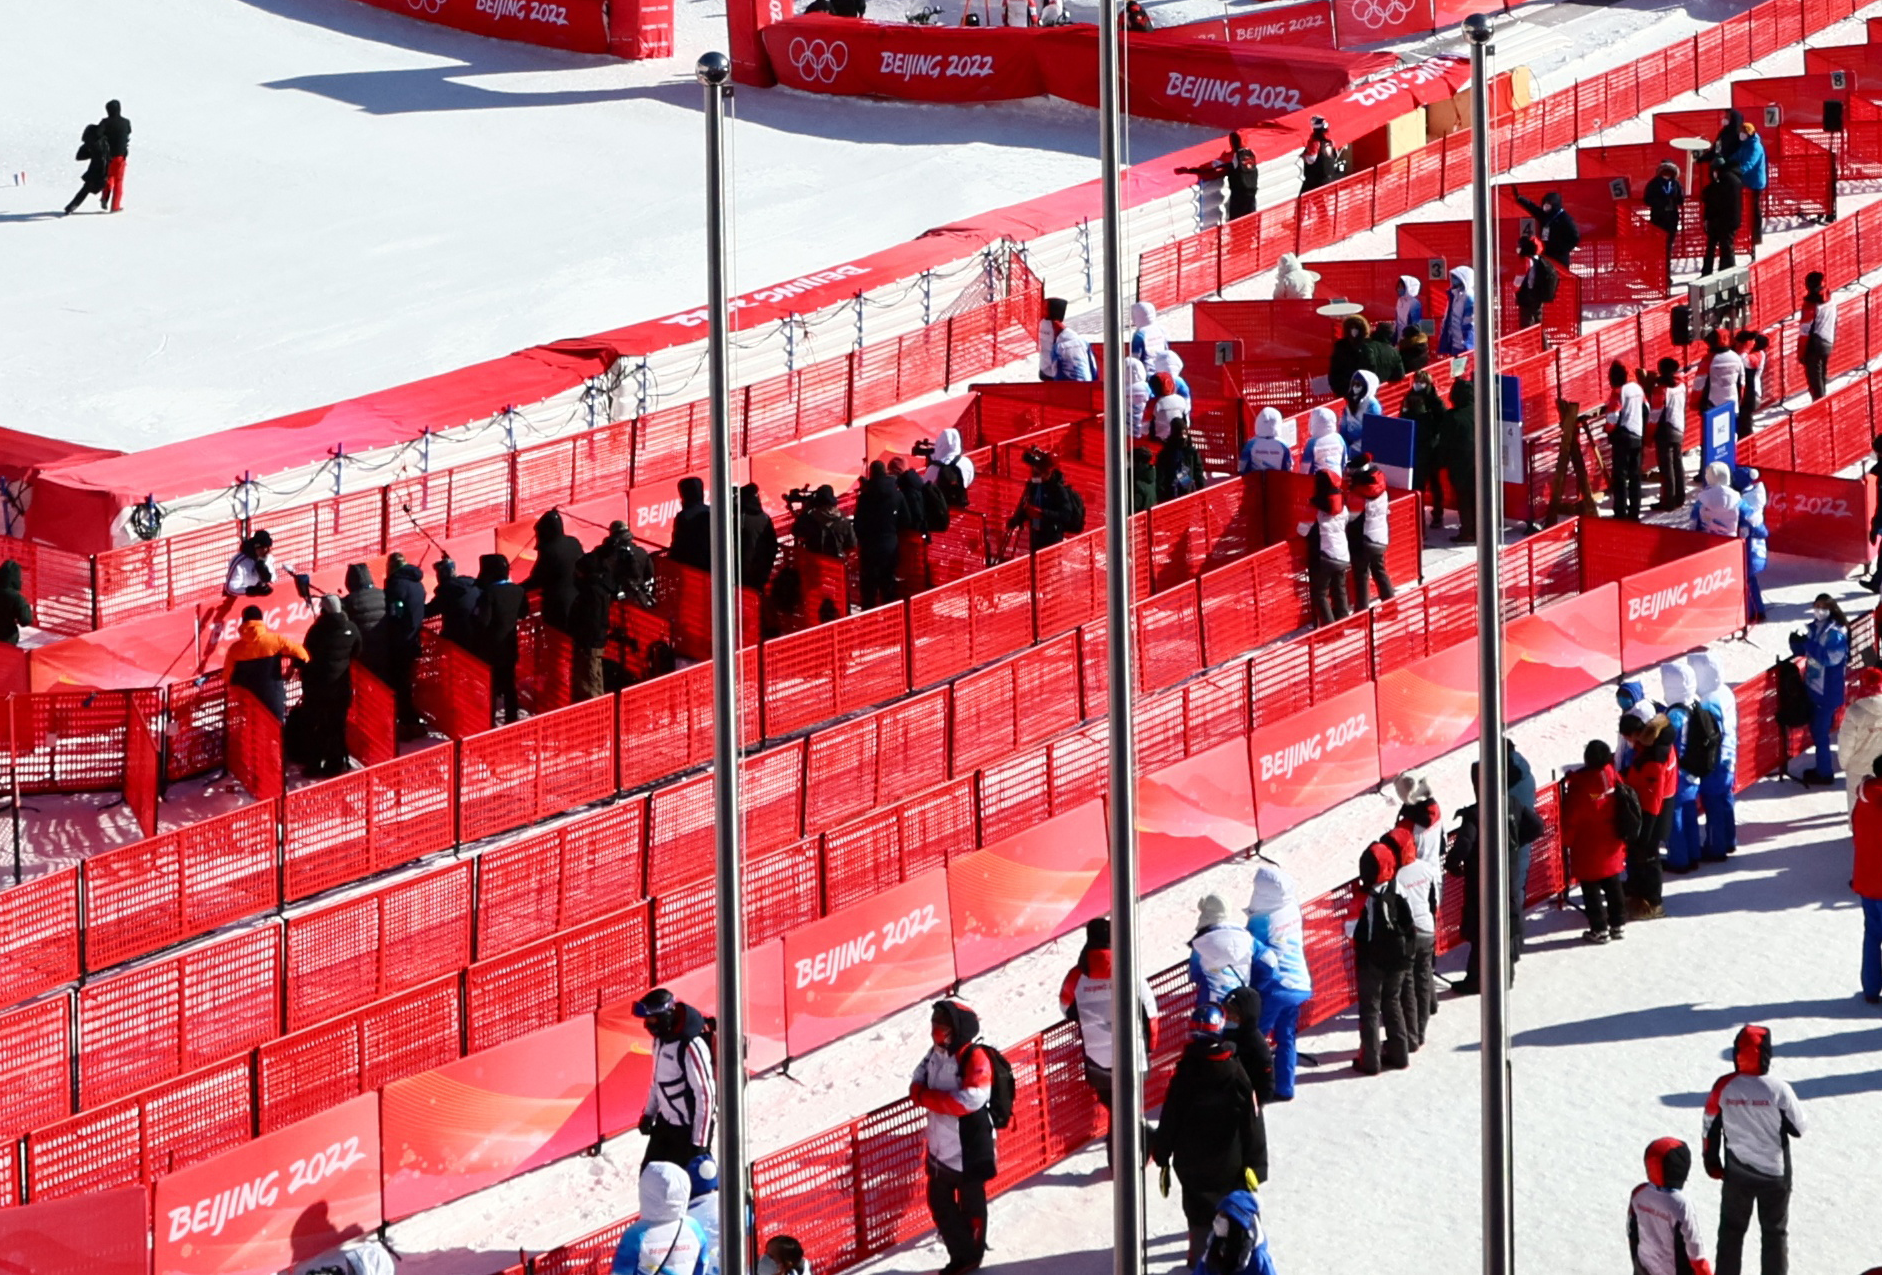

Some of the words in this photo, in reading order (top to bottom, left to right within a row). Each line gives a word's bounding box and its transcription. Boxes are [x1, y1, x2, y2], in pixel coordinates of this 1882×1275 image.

[530, 2, 570, 26] 2022
[1236, 22, 1285, 42] BEIJING
[1288, 15, 1326, 31] 2022
[881, 52, 942, 81] BEIJING
[946, 55, 994, 76] 2022
[1833, 73, 1843, 86] 8
[1166, 72, 1241, 107] BEIJING
[1248, 83, 1306, 112] 2022
[1768, 111, 1776, 122] 7
[1613, 184, 1623, 197] 5
[1522, 223, 1533, 236] 4
[1431, 262, 1442, 277] 3
[754, 264, 873, 304] BEIJING
[1219, 347, 1226, 363] 1
[1794, 489, 1853, 517] 2022
[1627, 582, 1688, 621] BEIJING
[1692, 566, 1736, 594] 2022
[1258, 733, 1322, 782] BEIJING
[1325, 712, 1370, 752] 2022
[794, 931, 876, 990] BEIJING
[881, 904, 941, 951] 2022
[168, 1170, 279, 1243] BEIJING
[286, 1136, 367, 1194] 2022
